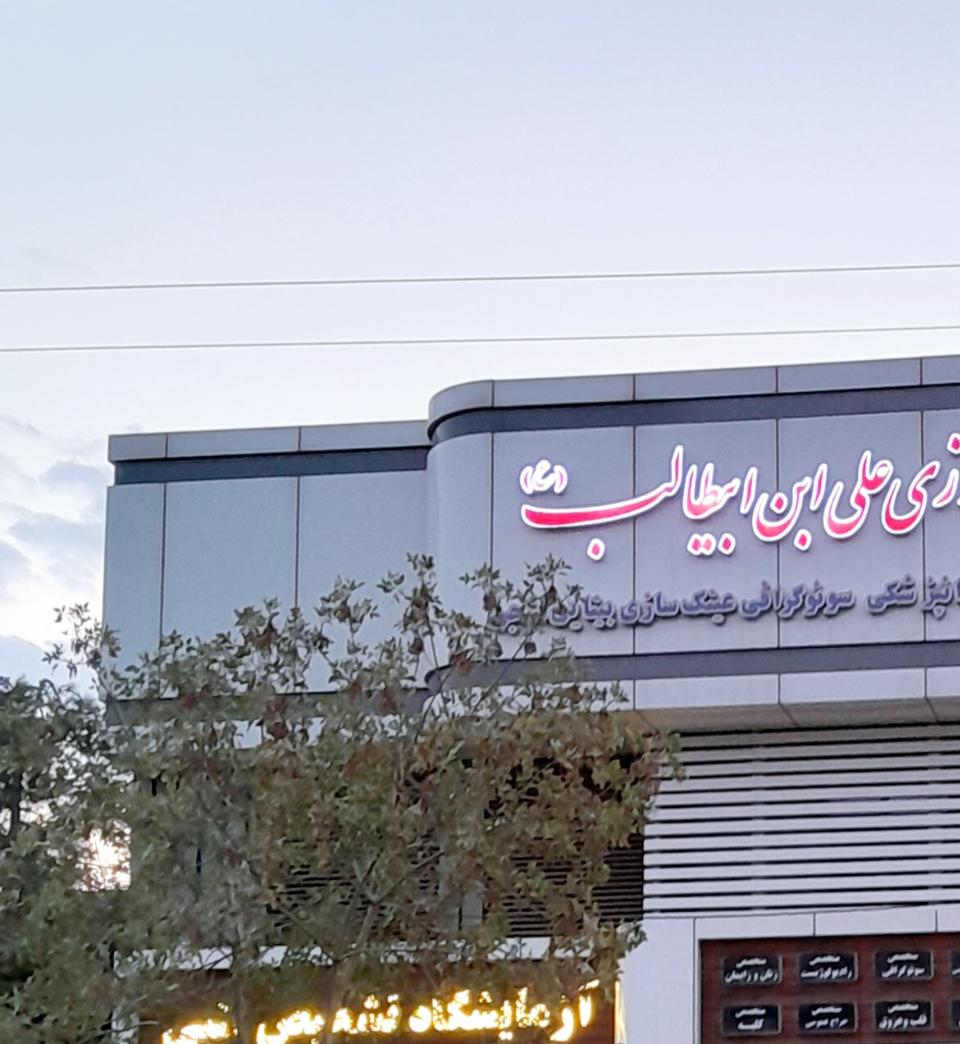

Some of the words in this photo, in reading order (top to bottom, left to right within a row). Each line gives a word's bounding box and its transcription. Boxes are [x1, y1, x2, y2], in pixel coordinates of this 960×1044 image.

[752, 462, 829, 551] ابن
[823, 449, 893, 540] علی
[741, 580, 857, 620] سونوگرافی
